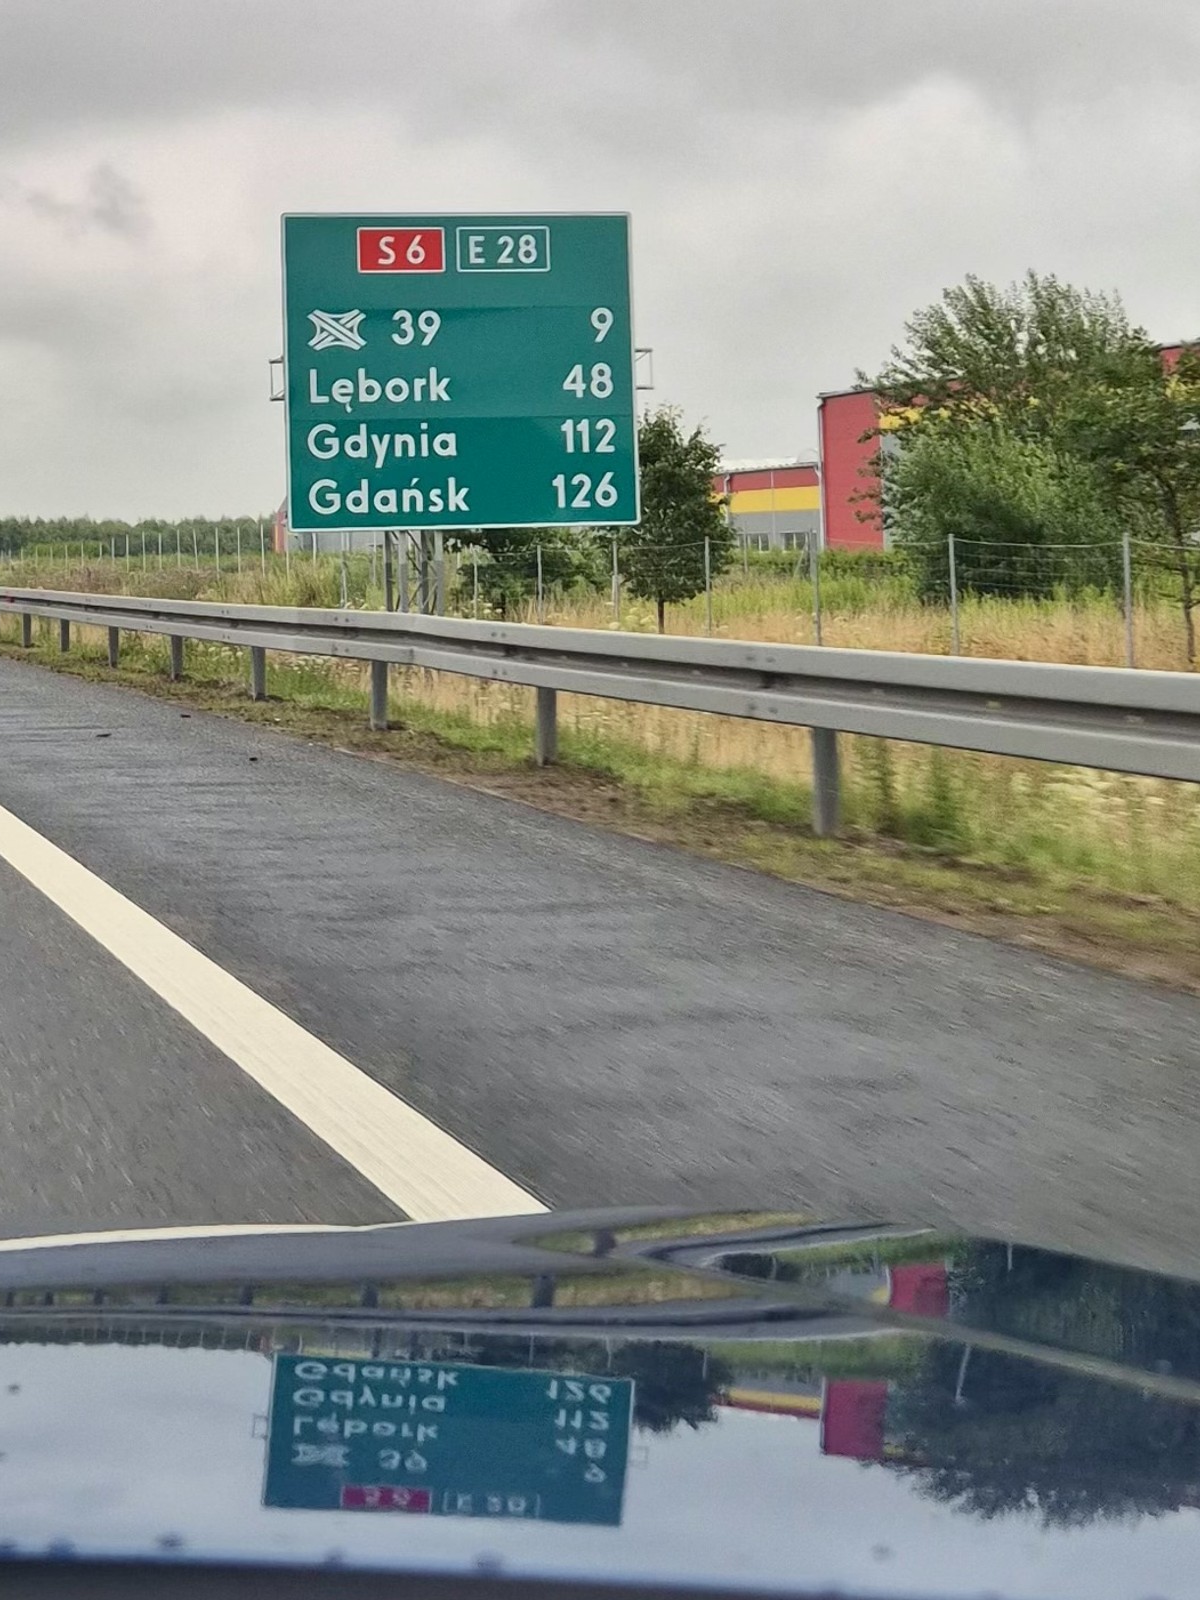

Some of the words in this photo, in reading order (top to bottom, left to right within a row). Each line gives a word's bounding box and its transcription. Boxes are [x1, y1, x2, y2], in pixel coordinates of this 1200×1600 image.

[378, 236, 395, 265] S
[407, 235, 426, 264] 6
[469, 236, 486, 264] E
[497, 234, 538, 264] 28
[392, 309, 441, 346] 39
[590, 307, 614, 343] 9
[309, 367, 451, 413] Lębork
[562, 362, 614, 399] 48
[307, 423, 457, 468] Gdynia
[561, 419, 616, 453] 112
[308, 477, 470, 515] Gdańsk
[552, 472, 618, 509] 126
